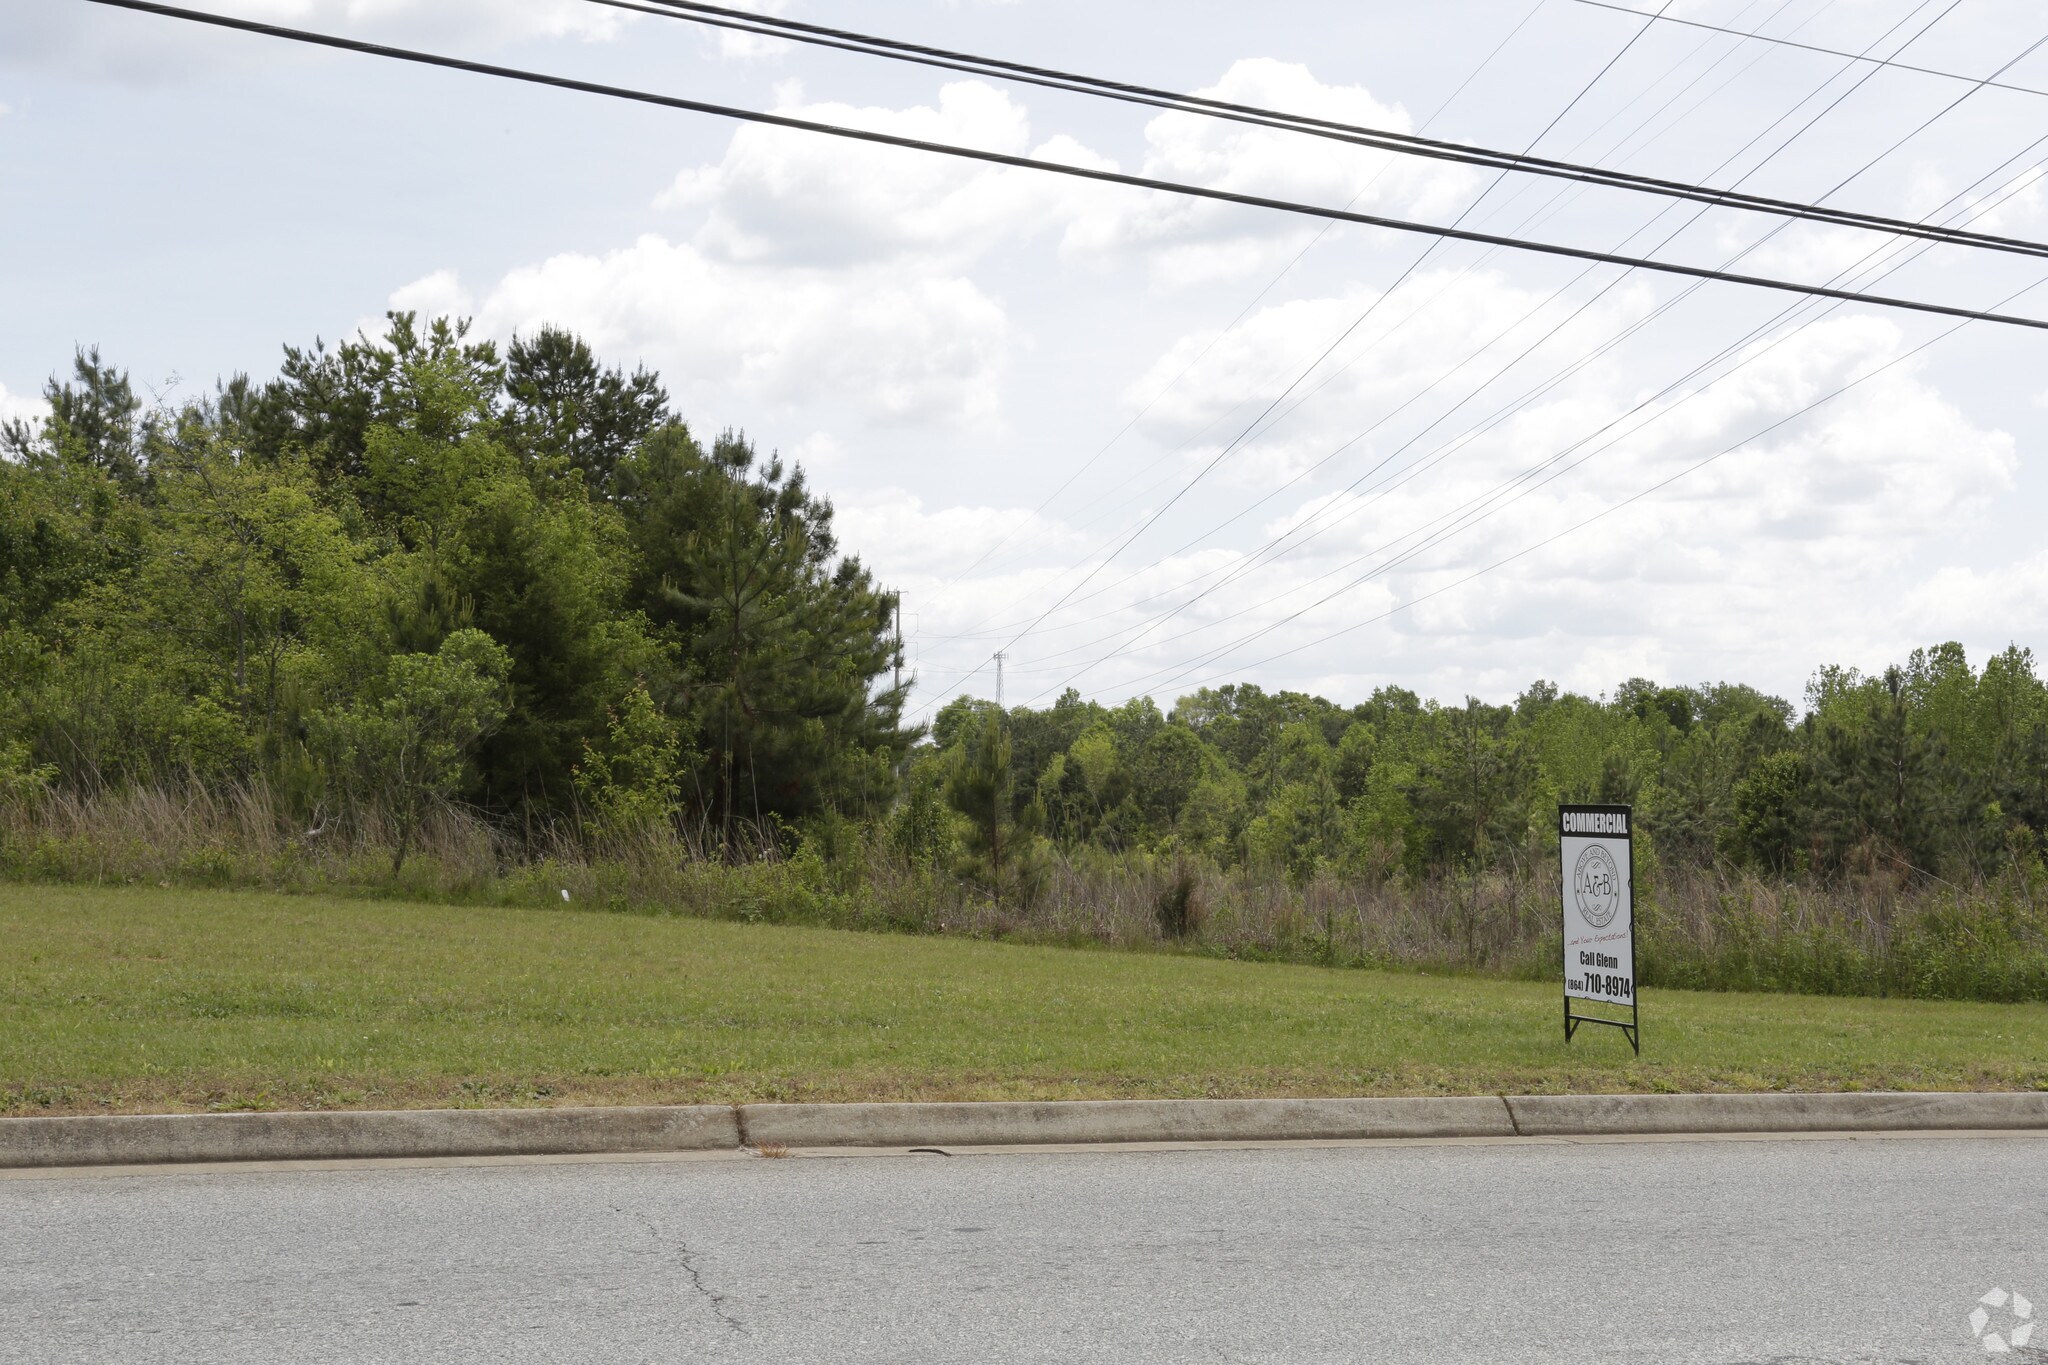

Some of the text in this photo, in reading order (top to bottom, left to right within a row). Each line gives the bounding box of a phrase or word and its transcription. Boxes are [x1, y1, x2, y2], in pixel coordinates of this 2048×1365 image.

[1562, 812, 1628, 834] COMMERCIAL
[1588, 847, 1601, 857] AND
[1600, 849, 1617, 881] BEYOND
[1583, 872, 1612, 897] A&B
[1583, 906, 1595, 924] REAL
[1580, 950, 1618, 969] Call Glenn
[1568, 972, 1631, 998] (864) 710-8974
